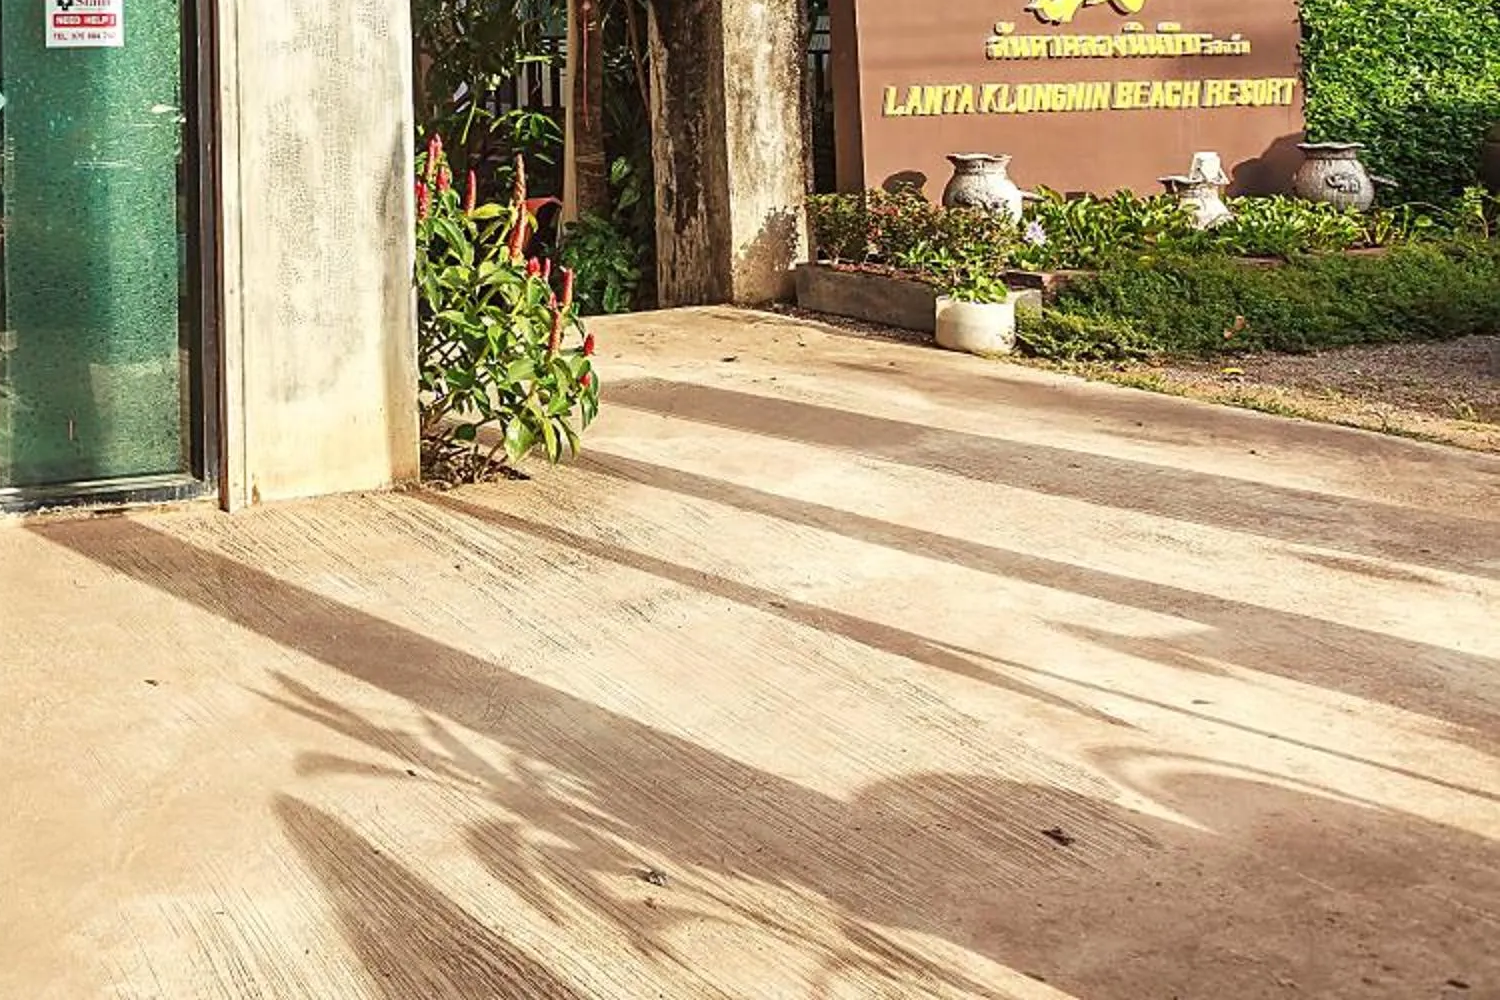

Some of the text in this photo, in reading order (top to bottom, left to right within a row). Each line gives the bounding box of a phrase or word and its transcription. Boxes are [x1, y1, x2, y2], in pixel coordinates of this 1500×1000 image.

[884, 84, 975, 116] LANTA
[1112, 80, 1200, 110] BEACH
[1201, 78, 1298, 108] RESORT
